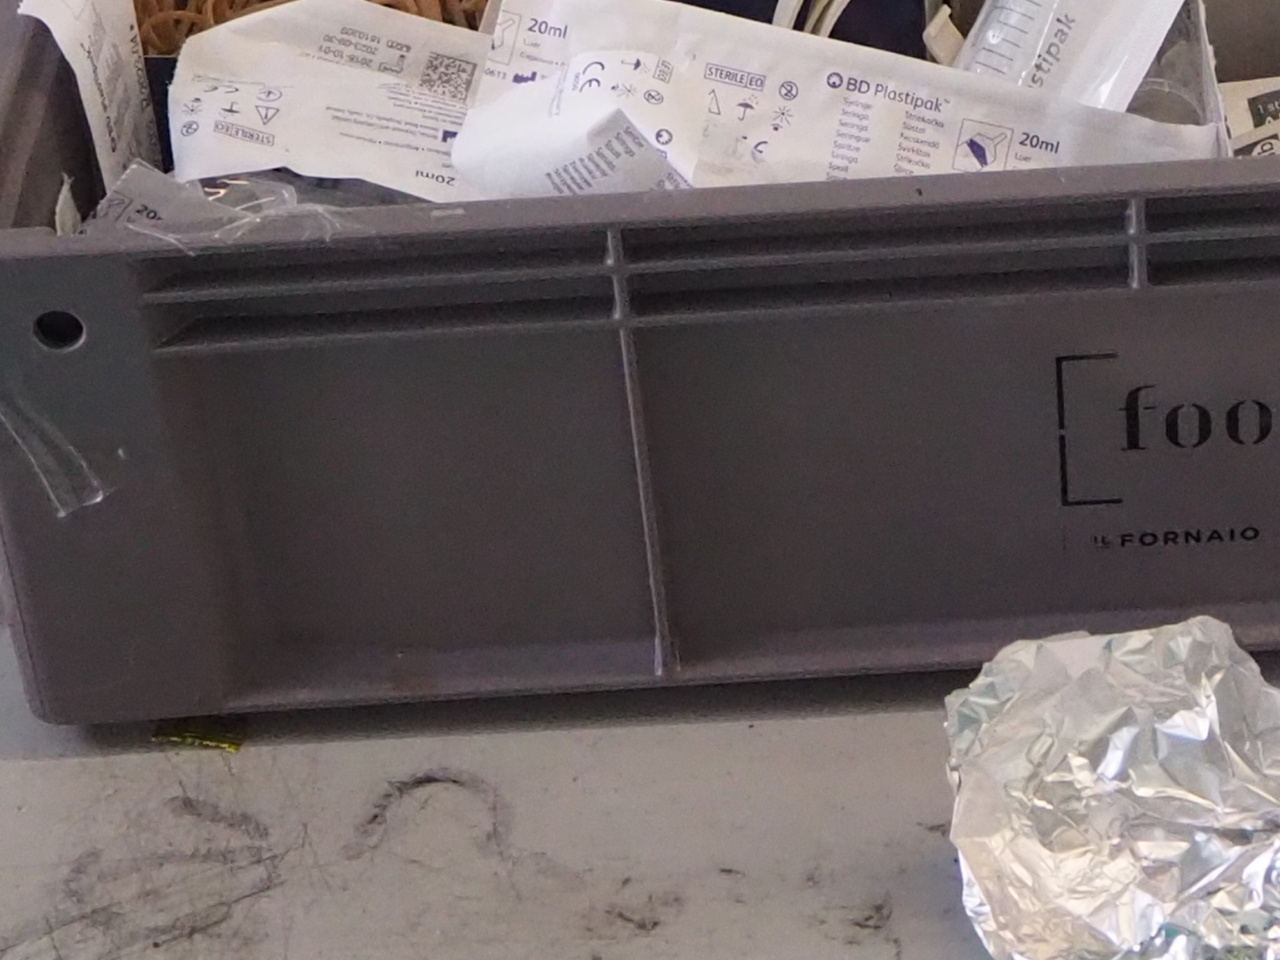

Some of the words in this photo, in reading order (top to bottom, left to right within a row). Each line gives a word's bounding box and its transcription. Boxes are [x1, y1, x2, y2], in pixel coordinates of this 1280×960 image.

[526, 17, 569, 40] 20ml
[1027, 11, 1077, 89] stipak
[707, 66, 746, 85] STERILE
[846, 77, 871, 95] BD
[874, 83, 943, 113] Plastipak
[1018, 131, 1061, 155] 20ml
[1120, 526, 1260, 547] FORNAIO
